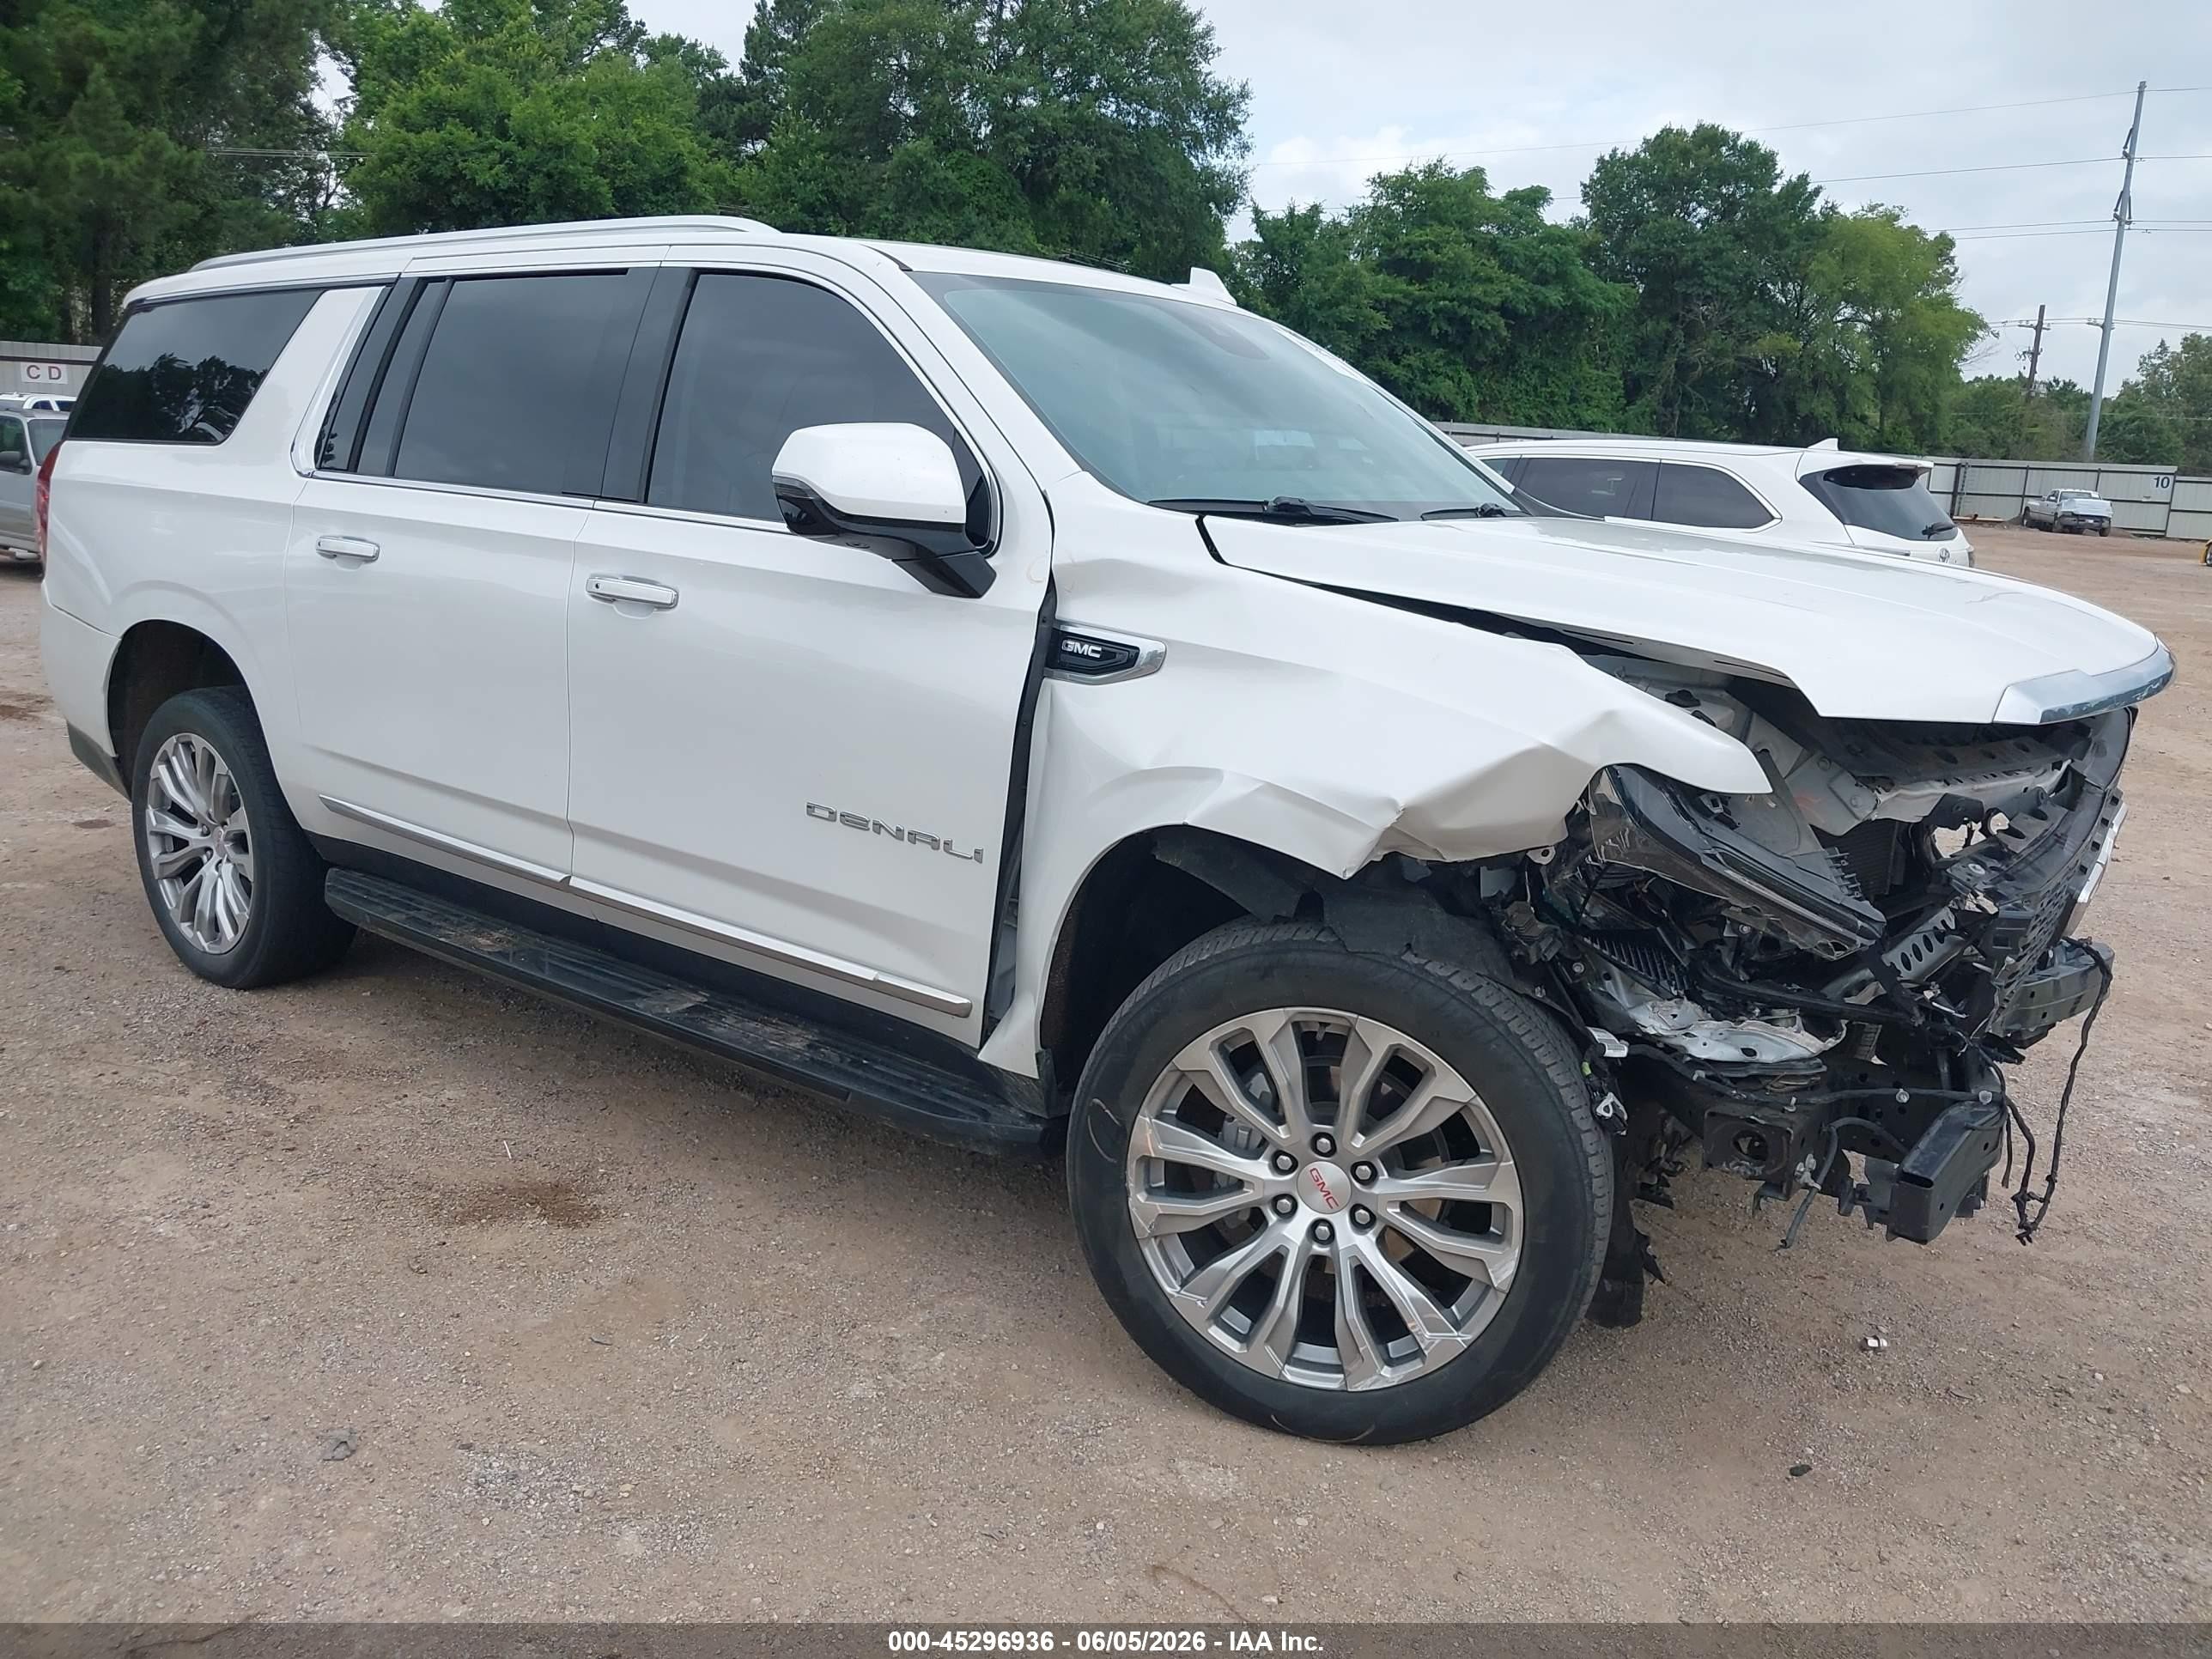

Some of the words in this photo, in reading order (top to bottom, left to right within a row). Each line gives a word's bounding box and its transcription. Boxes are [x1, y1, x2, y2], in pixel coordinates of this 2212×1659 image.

[2153, 476, 2171, 489] 10
[1061, 639, 1102, 659] GMC
[805, 801, 984, 865] DENALI
[1310, 1167, 1340, 1210] GMC
